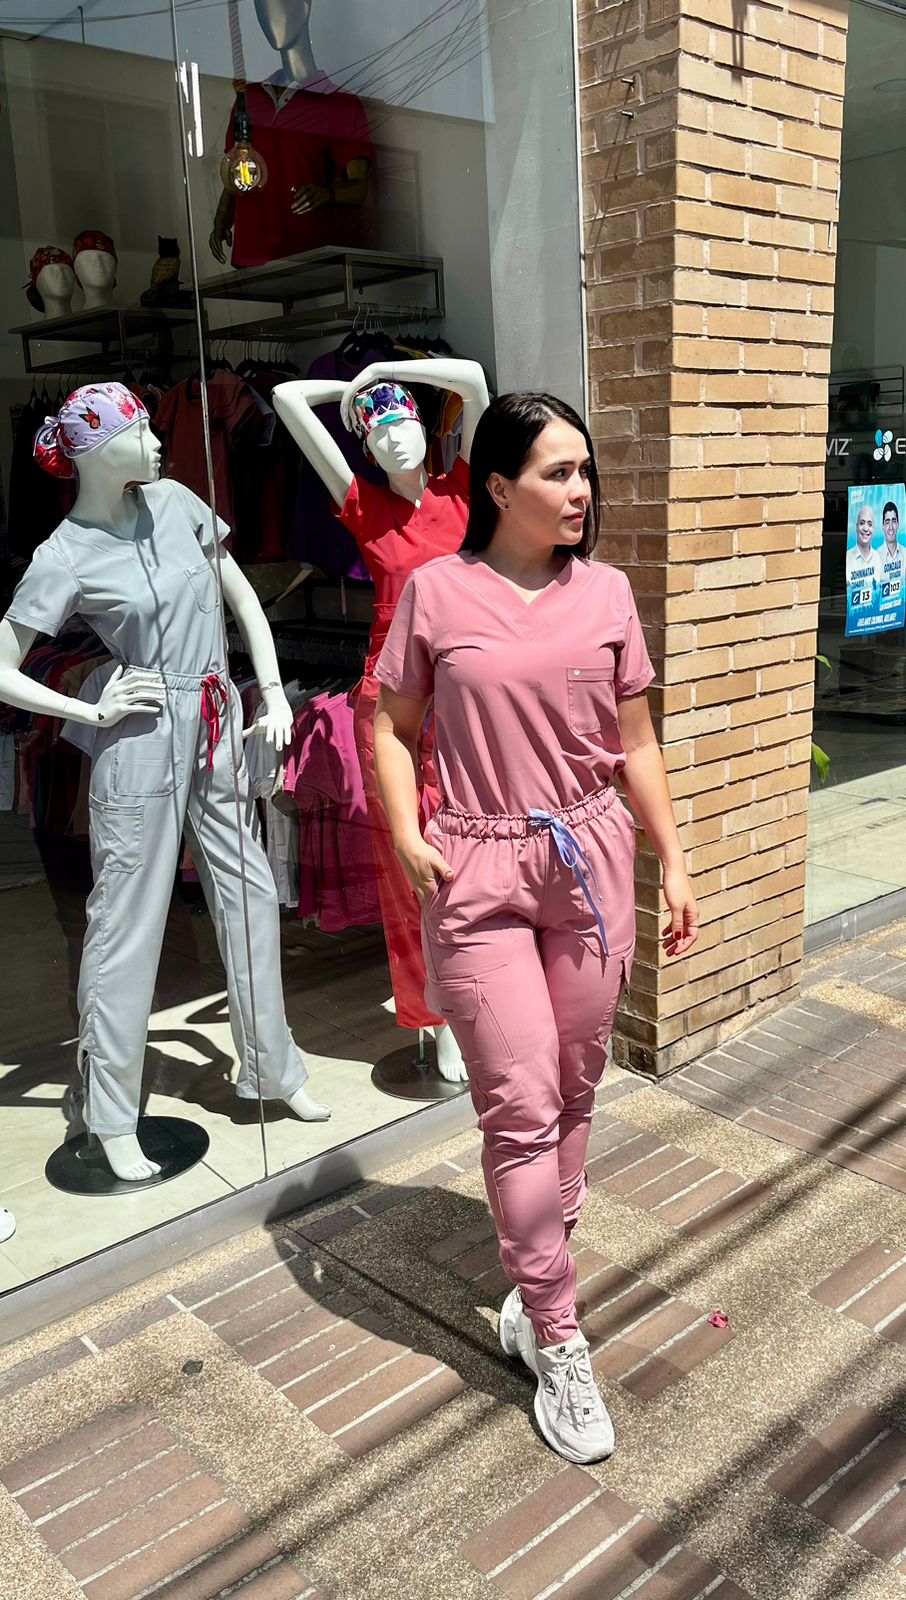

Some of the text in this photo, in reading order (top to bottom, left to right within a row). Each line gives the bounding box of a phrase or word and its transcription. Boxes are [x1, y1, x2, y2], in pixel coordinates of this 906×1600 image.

[884, 561, 901, 573] GONZALO
[891, 583, 899, 592] 103
[862, 591, 870, 601] 13
